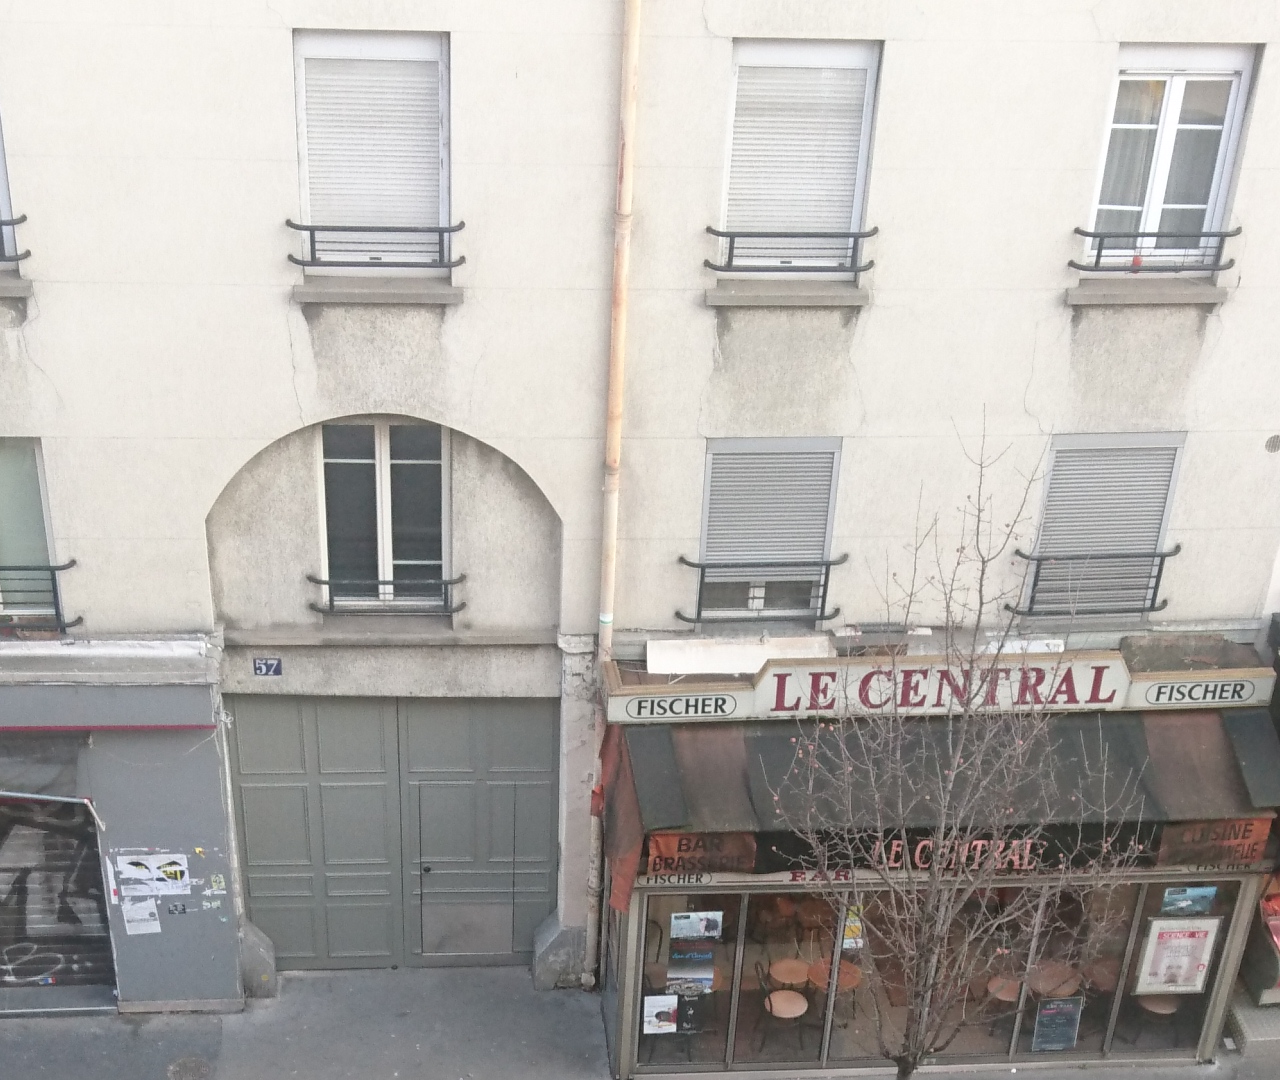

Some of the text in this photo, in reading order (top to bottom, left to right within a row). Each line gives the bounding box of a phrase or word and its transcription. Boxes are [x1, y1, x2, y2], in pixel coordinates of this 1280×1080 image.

[255, 659, 278, 675] 57
[770, 666, 1117, 711] LE CENTRAL
[1155, 683, 1245, 702] FISCHER
[637, 697, 727, 716] FISCHER
[1183, 822, 1254, 842] CUISINE
[677, 837, 721, 853] BAR
[872, 838, 1038, 869] LE CNTRAL
[652, 856, 745, 873] BRASSERIE
[646, 872, 704, 885] FISCHER
